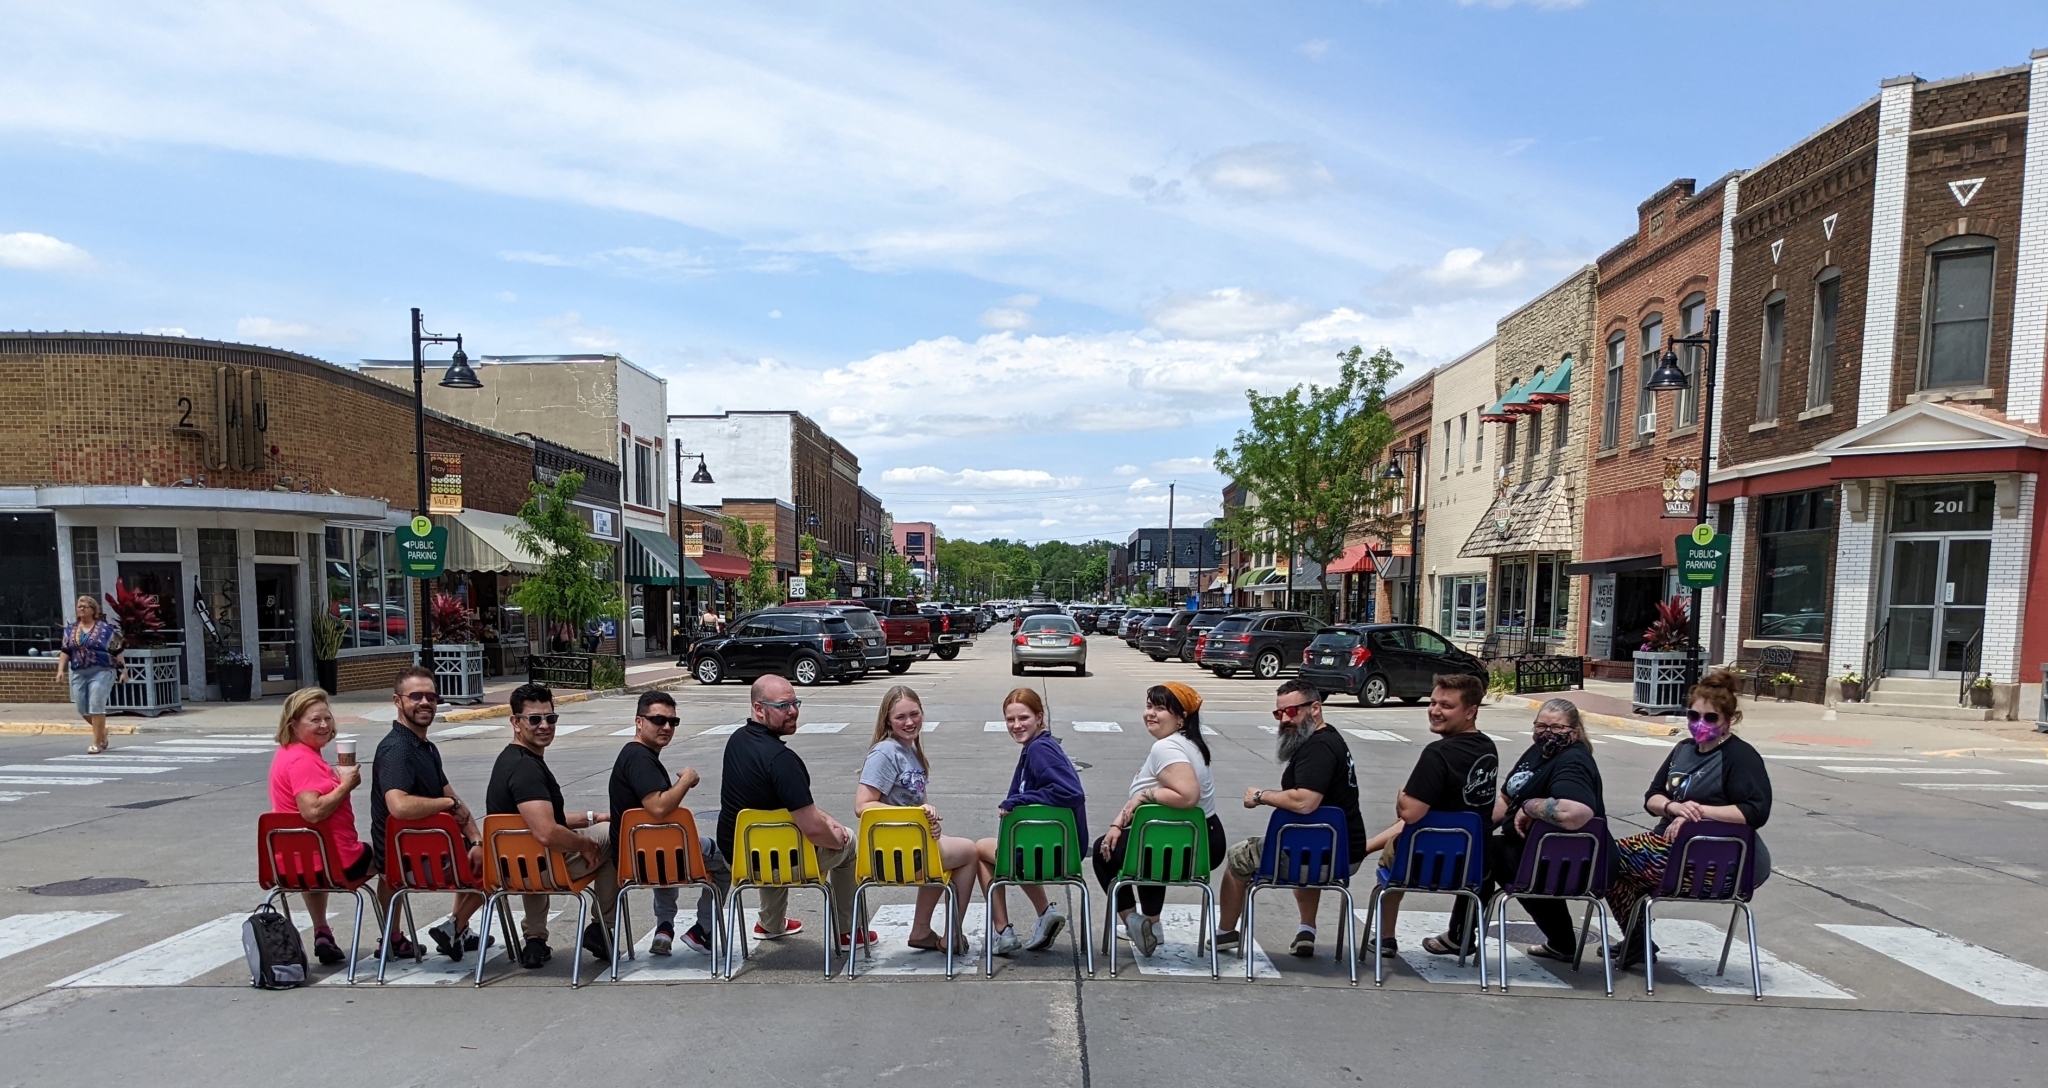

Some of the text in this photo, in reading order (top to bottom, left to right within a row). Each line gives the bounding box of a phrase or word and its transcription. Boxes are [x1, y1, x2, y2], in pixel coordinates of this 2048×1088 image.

[431, 465, 446, 474] Play
[434, 497, 459, 507] VALLEY
[1665, 501, 1691, 512] VALLEY
[1933, 500, 1963, 513] 201
[417, 520, 427, 532] P
[1698, 528, 1708, 540] P
[410, 541, 434, 549] PUBLIC
[408, 551, 437, 560] PARKING
[1689, 550, 1714, 558] PUBLIC
[1685, 561, 1717, 569] PARKING
[791, 587, 805, 595] 20
[1597, 585, 1613, 596] WE'VE
[1596, 597, 1613, 608] MOVED
